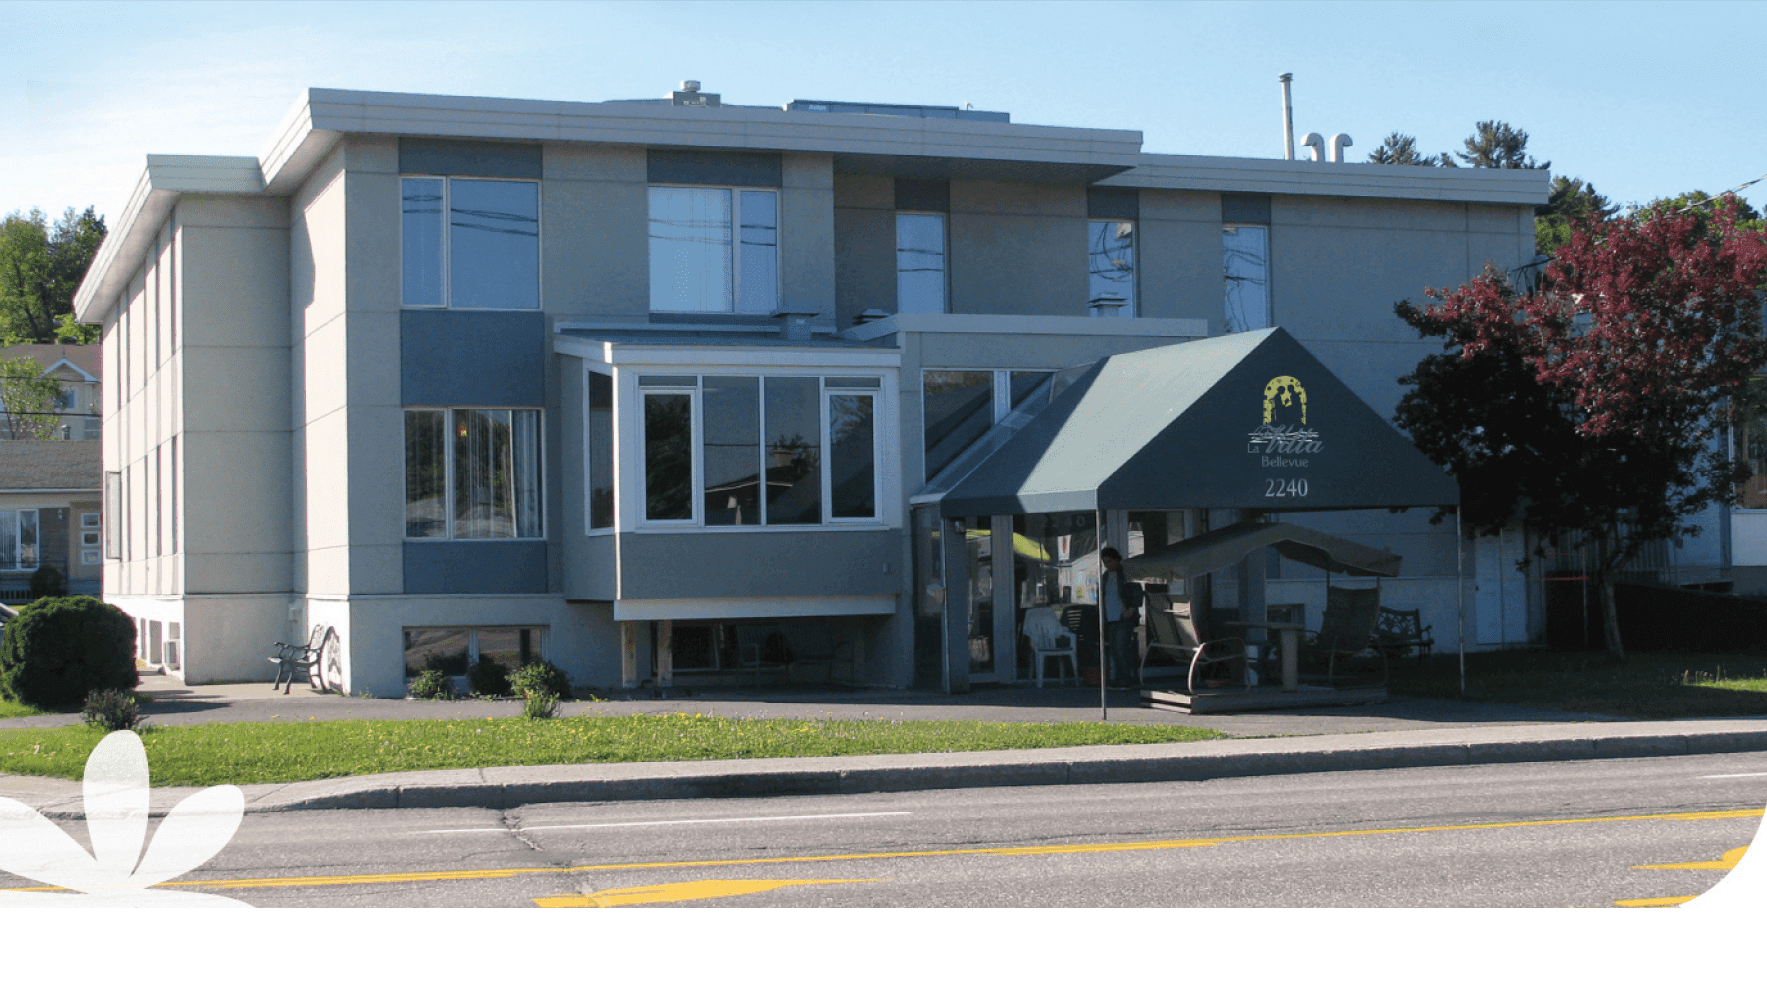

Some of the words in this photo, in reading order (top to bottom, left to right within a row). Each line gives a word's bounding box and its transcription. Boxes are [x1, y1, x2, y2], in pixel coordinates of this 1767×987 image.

[1247, 442, 1260, 453] La
[1261, 455, 1309, 468] Bellevue
[1265, 478, 1308, 497] 2240
